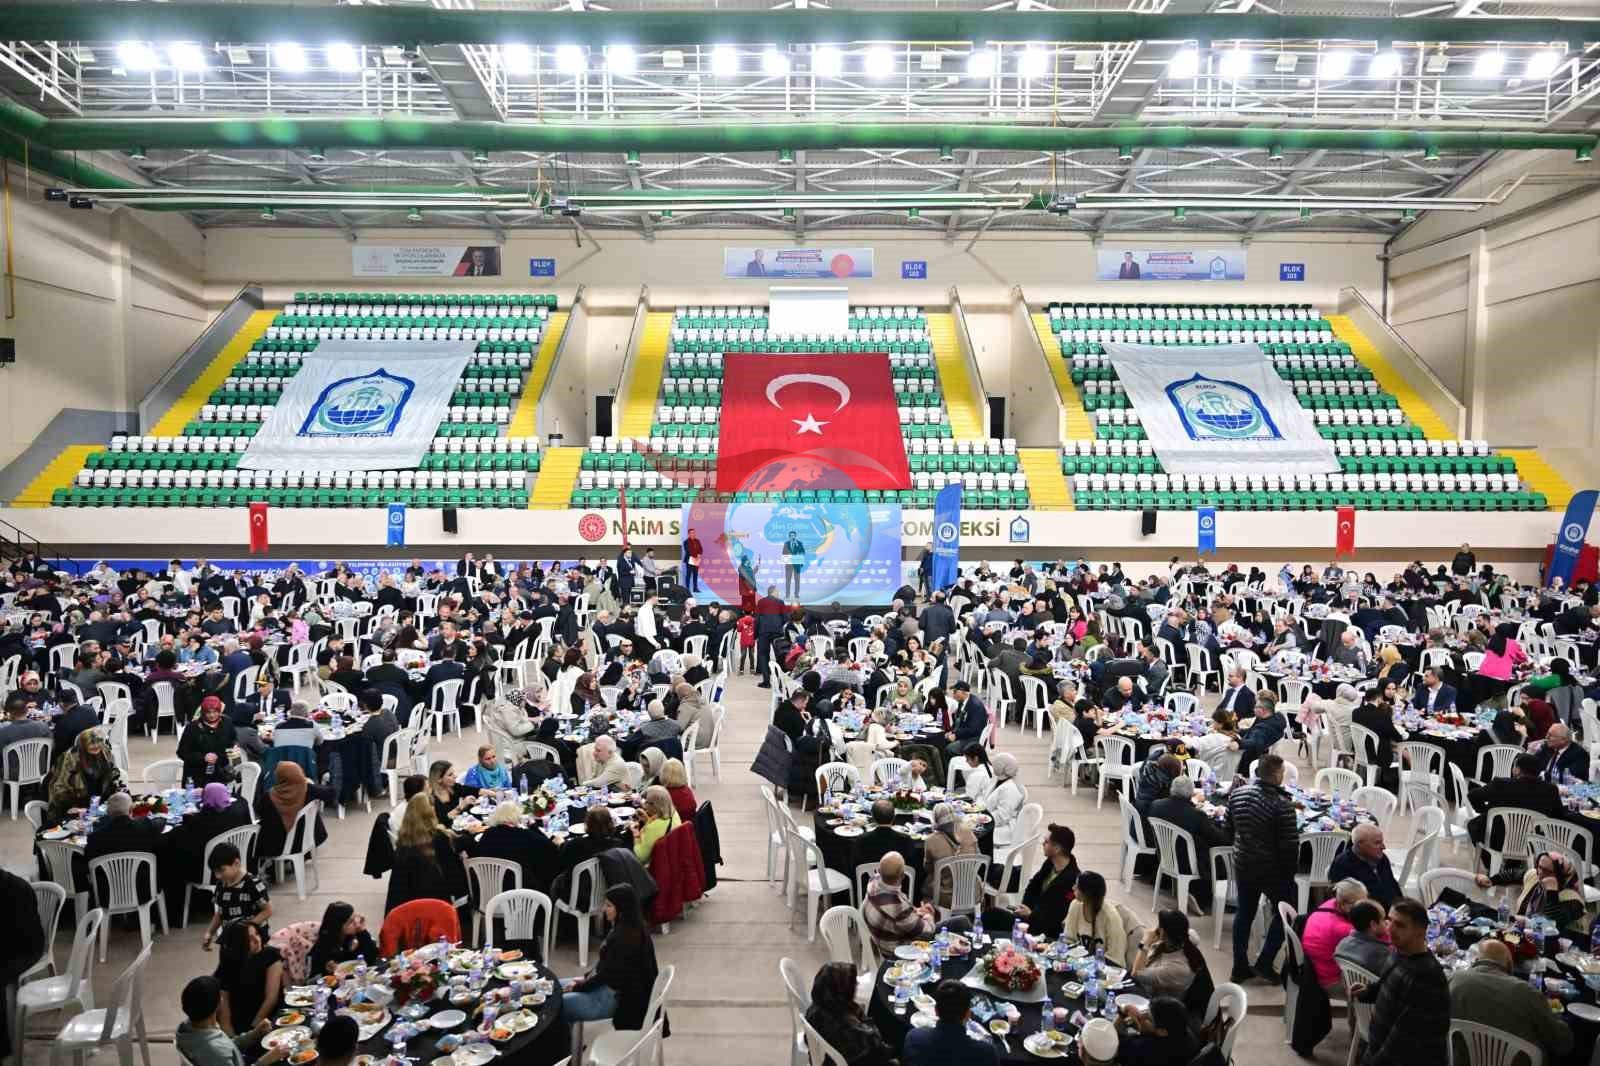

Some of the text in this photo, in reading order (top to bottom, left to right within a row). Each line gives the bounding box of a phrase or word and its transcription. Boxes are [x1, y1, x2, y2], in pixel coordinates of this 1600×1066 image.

[905, 263, 925, 271] BLOK
[1283, 265, 1302, 273] BLOK
[613, 516, 664, 536] NAİM
